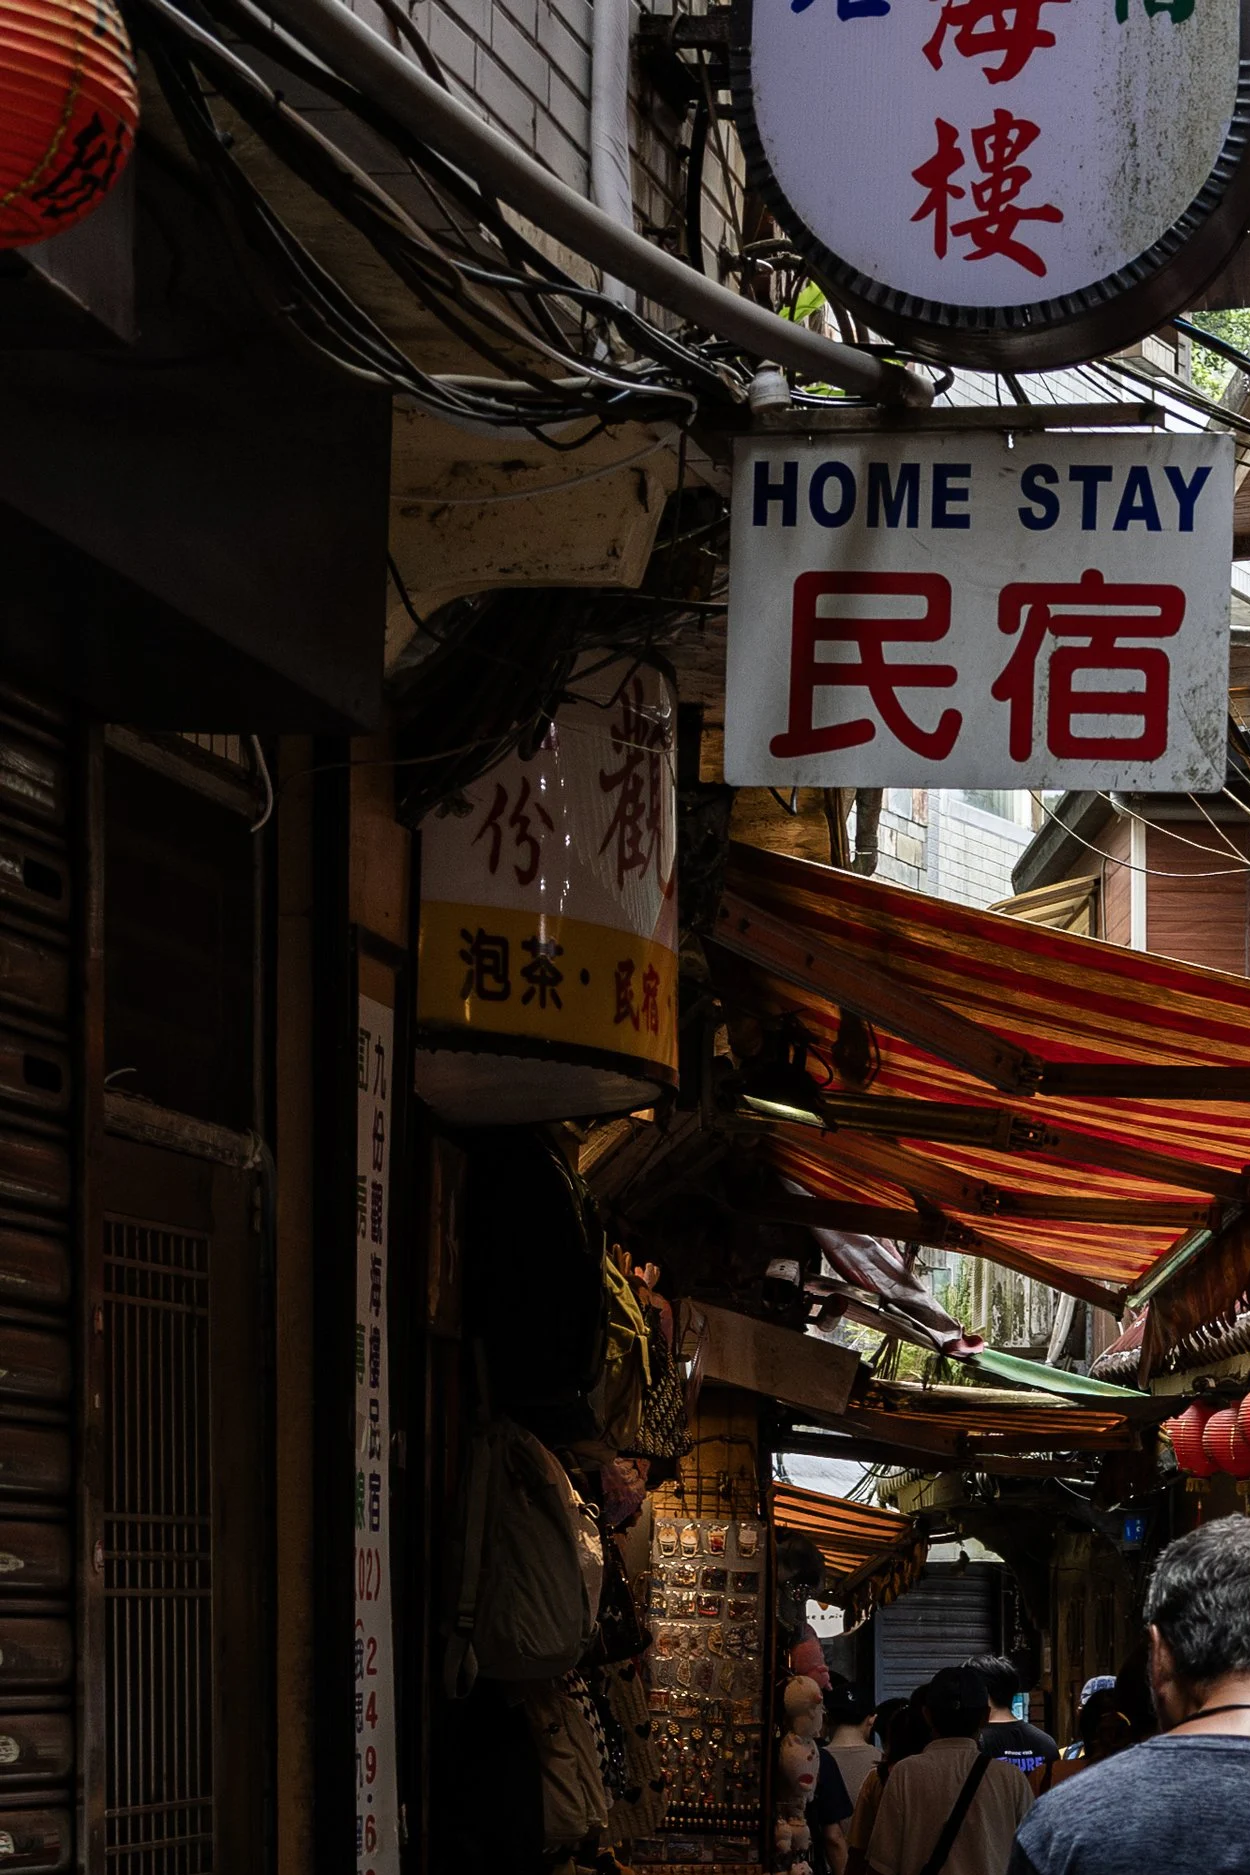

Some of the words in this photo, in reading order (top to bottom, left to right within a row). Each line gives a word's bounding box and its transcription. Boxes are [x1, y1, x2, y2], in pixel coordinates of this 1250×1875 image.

[752, 461, 971, 529] HOME
[1018, 465, 1212, 533] STAY
[769, 568, 1186, 762] 民宿
